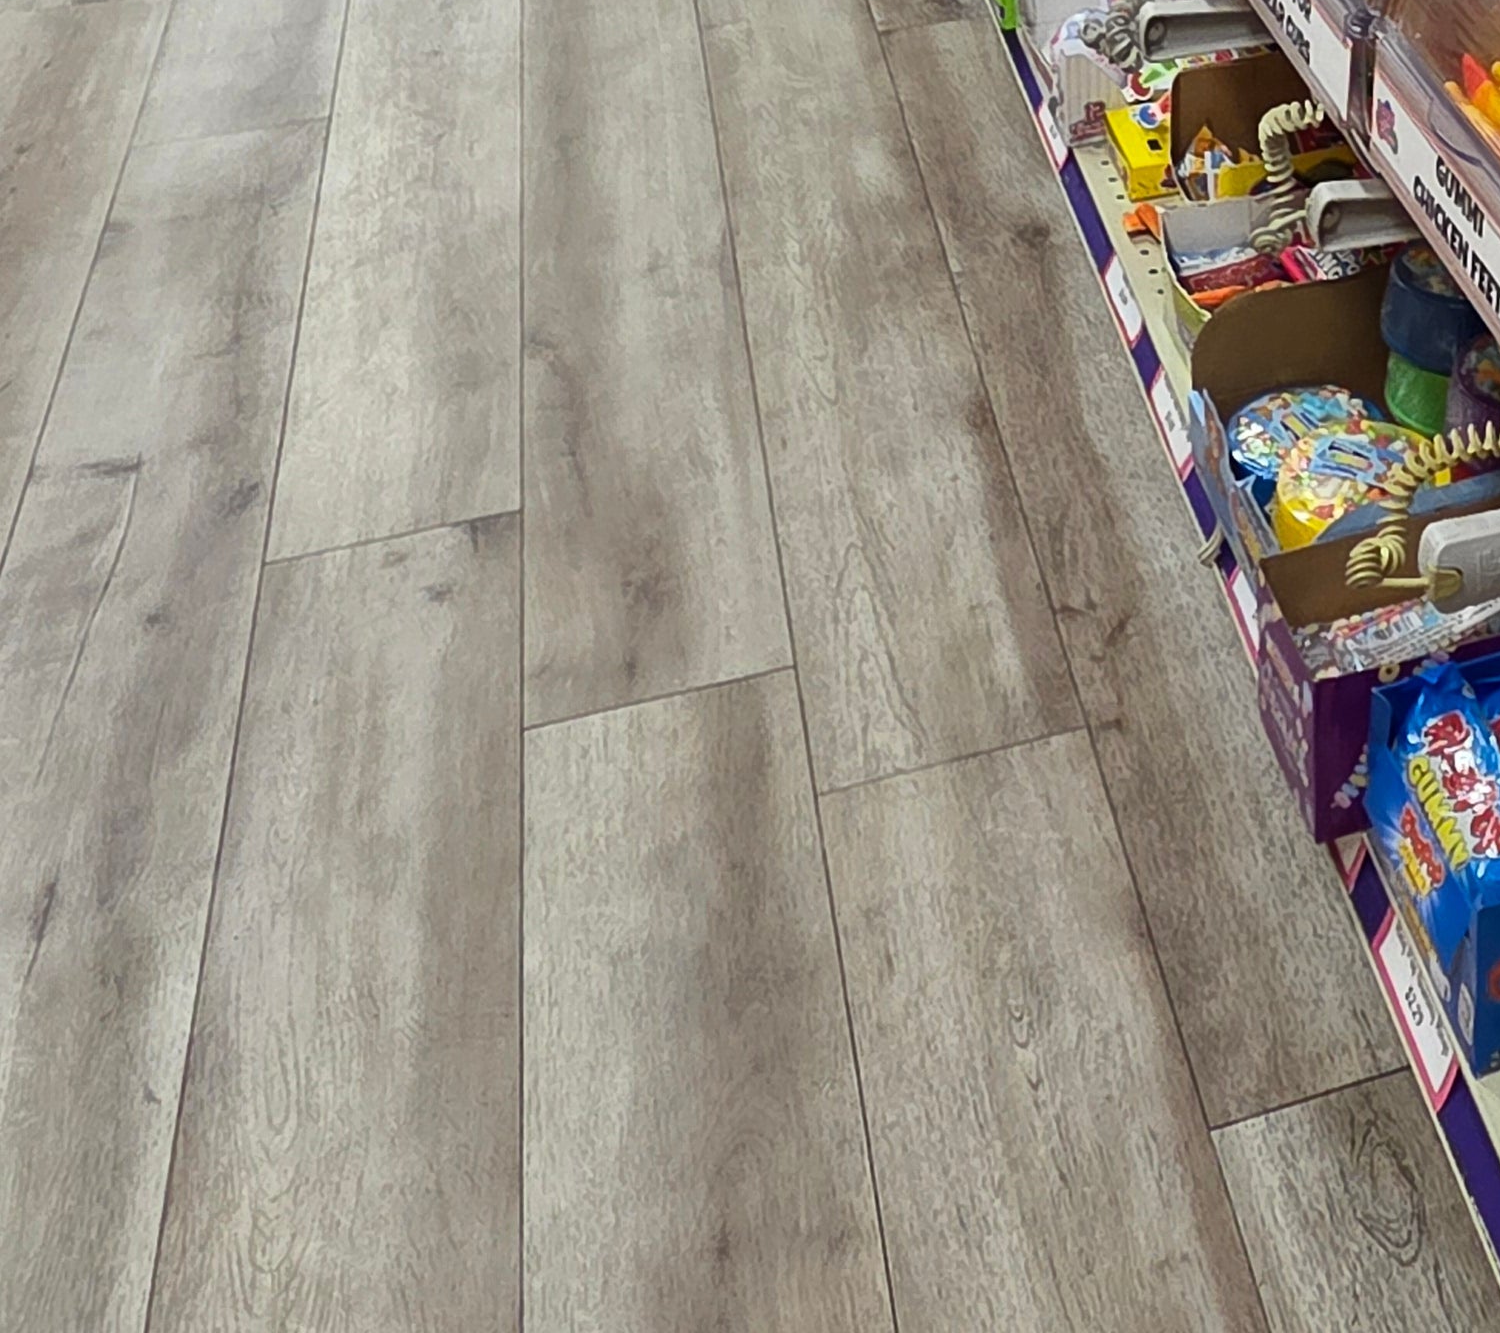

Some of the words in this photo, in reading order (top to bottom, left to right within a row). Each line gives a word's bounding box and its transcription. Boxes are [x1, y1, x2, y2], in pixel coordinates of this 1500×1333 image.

[1413, 176, 1468, 265] CHICKEN
[1436, 156, 1485, 238] GUMMI
[1407, 757, 1470, 873] GUMMY
